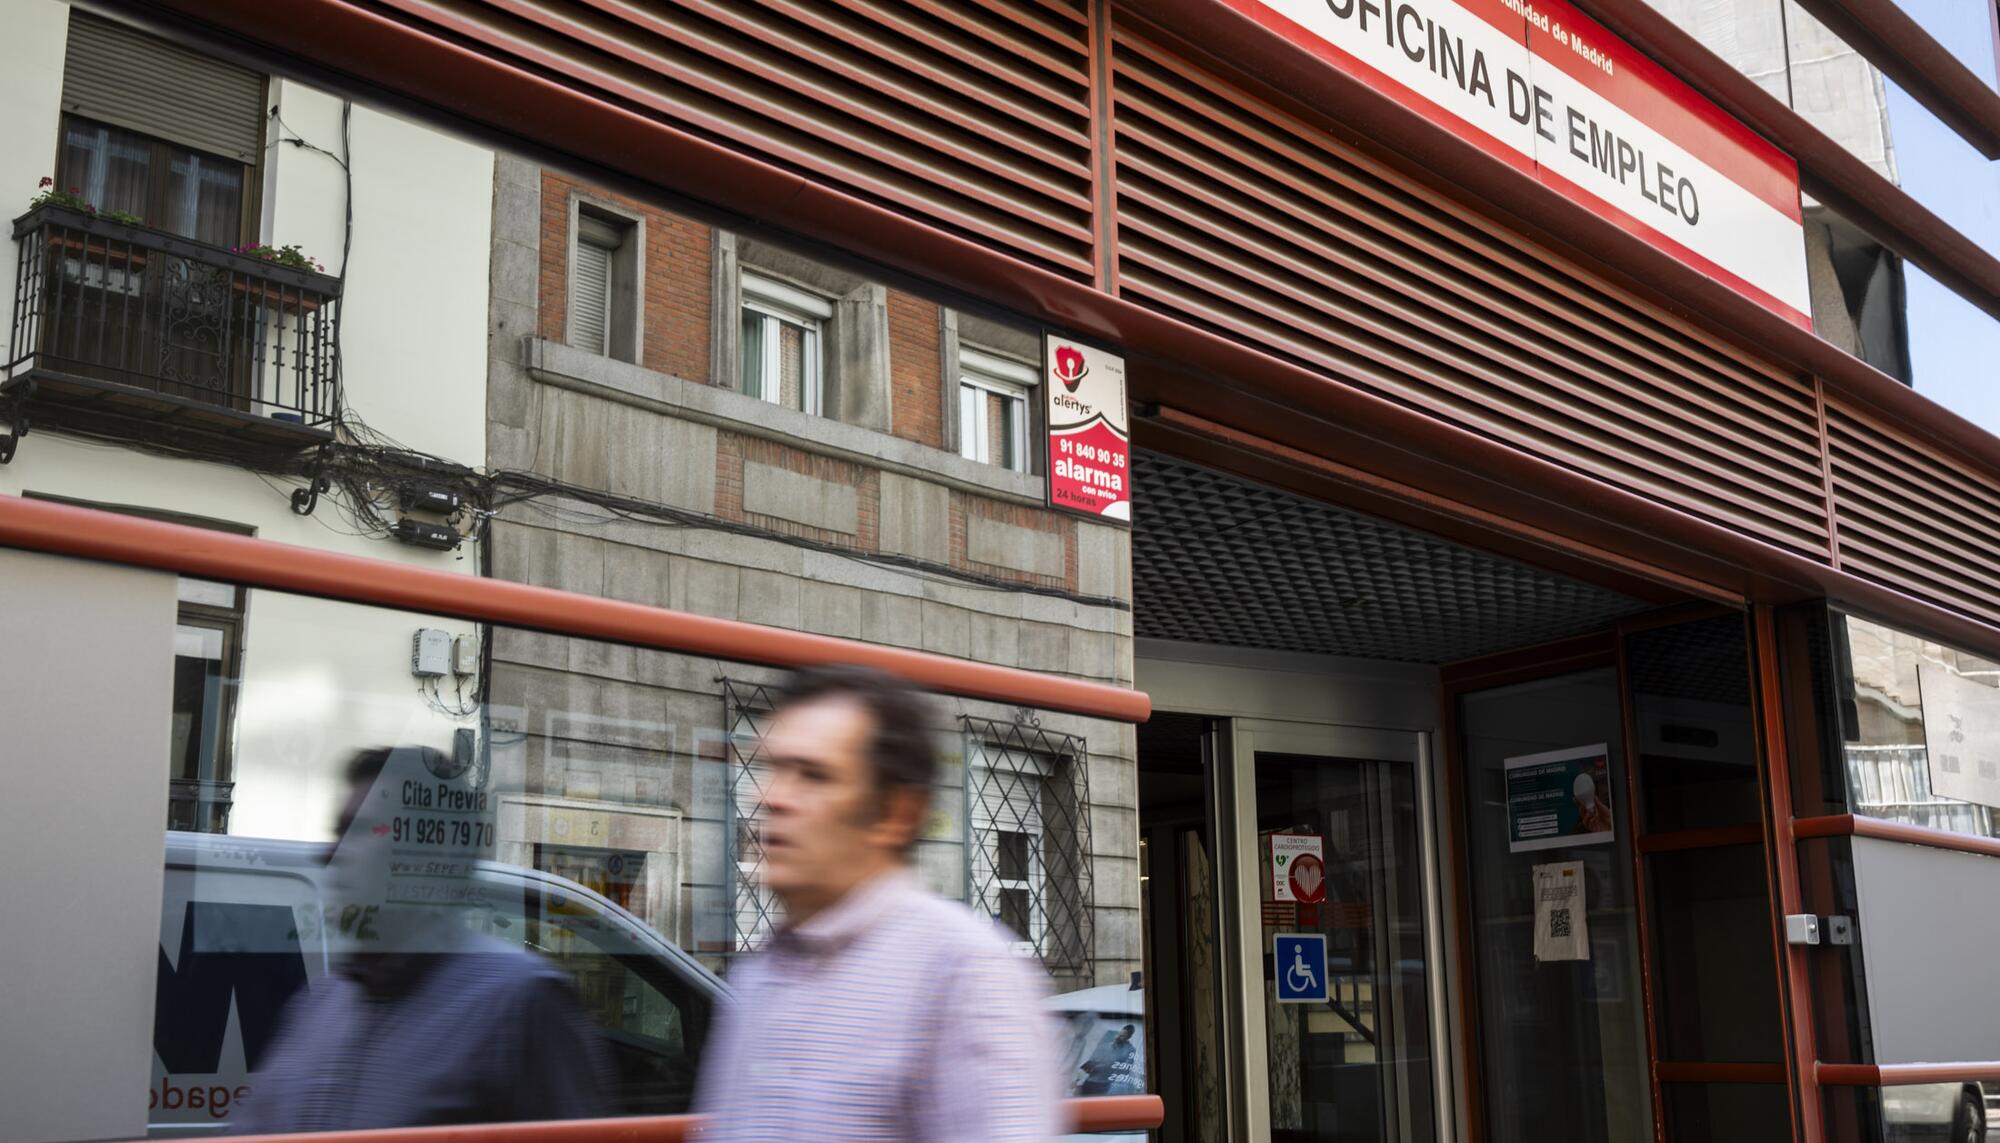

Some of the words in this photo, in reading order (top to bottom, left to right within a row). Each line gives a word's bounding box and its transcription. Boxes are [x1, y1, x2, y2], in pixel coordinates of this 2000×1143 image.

[1501, 0, 1549, 32] unidad
[1552, 23, 1568, 45] de
[1571, 33, 1613, 76] Madrid
[1507, 67, 1556, 143] DE
[1566, 104, 1699, 226] EMPLEO
[1053, 394, 1090, 415] alertys
[1060, 439, 1073, 454] 91
[1076, 443, 1095, 459] 840
[1097, 449, 1110, 464] 90
[1112, 453, 1125, 468] 35
[1055, 457, 1122, 491] alarma
[1056, 488, 1068, 500] 24
[1070, 491, 1097, 507] horas
[1081, 485, 1096, 496] con
[1097, 489, 1117, 501] aviso
[402, 780, 431, 807] Cita
[438, 784, 487, 810] Previa
[393, 817, 410, 841] 91
[416, 819, 445, 845] 926
[451, 821, 470, 846] 79
[476, 822, 493, 847] 70
